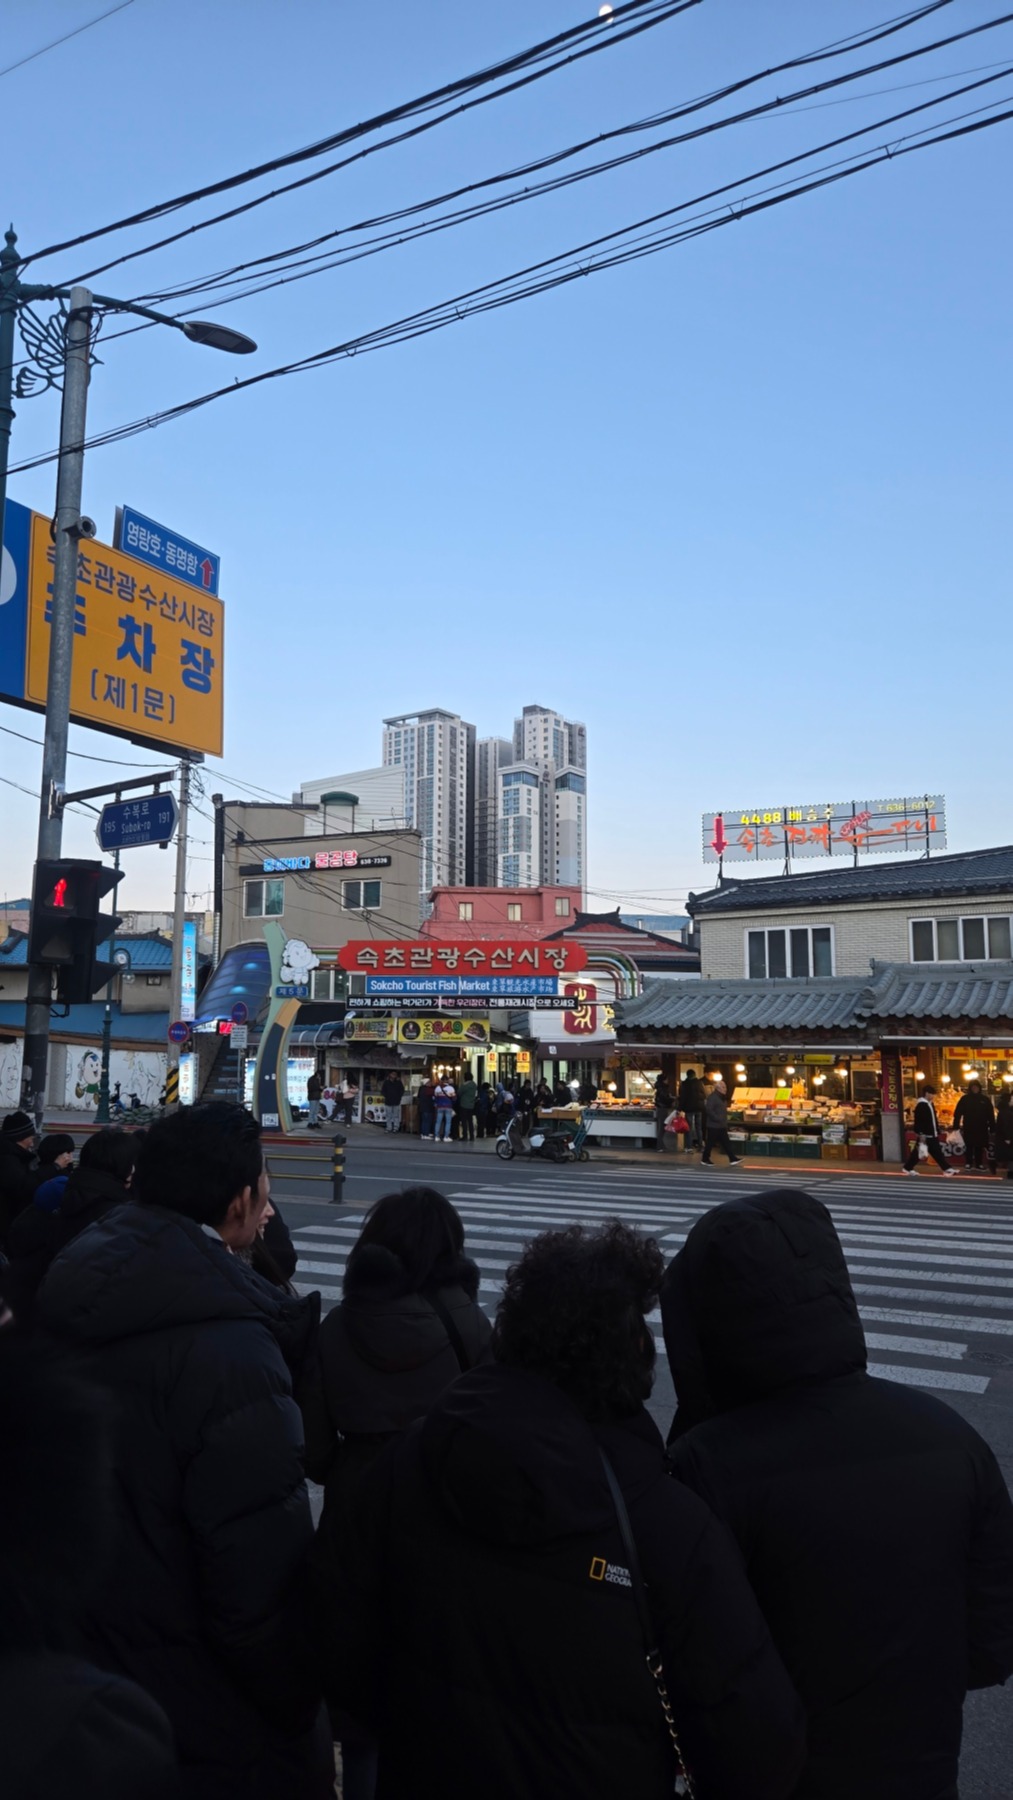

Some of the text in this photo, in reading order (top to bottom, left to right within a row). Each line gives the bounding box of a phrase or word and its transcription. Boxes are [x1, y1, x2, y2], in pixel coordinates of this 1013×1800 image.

[127, 520, 198, 576] 영랑호·동명항
[91, 668, 175, 724] (제1문)
[123, 802, 150, 820] 수복로
[158, 812, 170, 824] 191
[740, 811, 781, 825] 4488
[104, 821, 116, 833] 195
[121, 821, 151, 834] Subok-ro
[356, 946, 569, 970] 속초관광수산시장
[371, 980, 490, 991] Sokcho Tourist Fish Market
[423, 1020, 463, 1034] 3849
